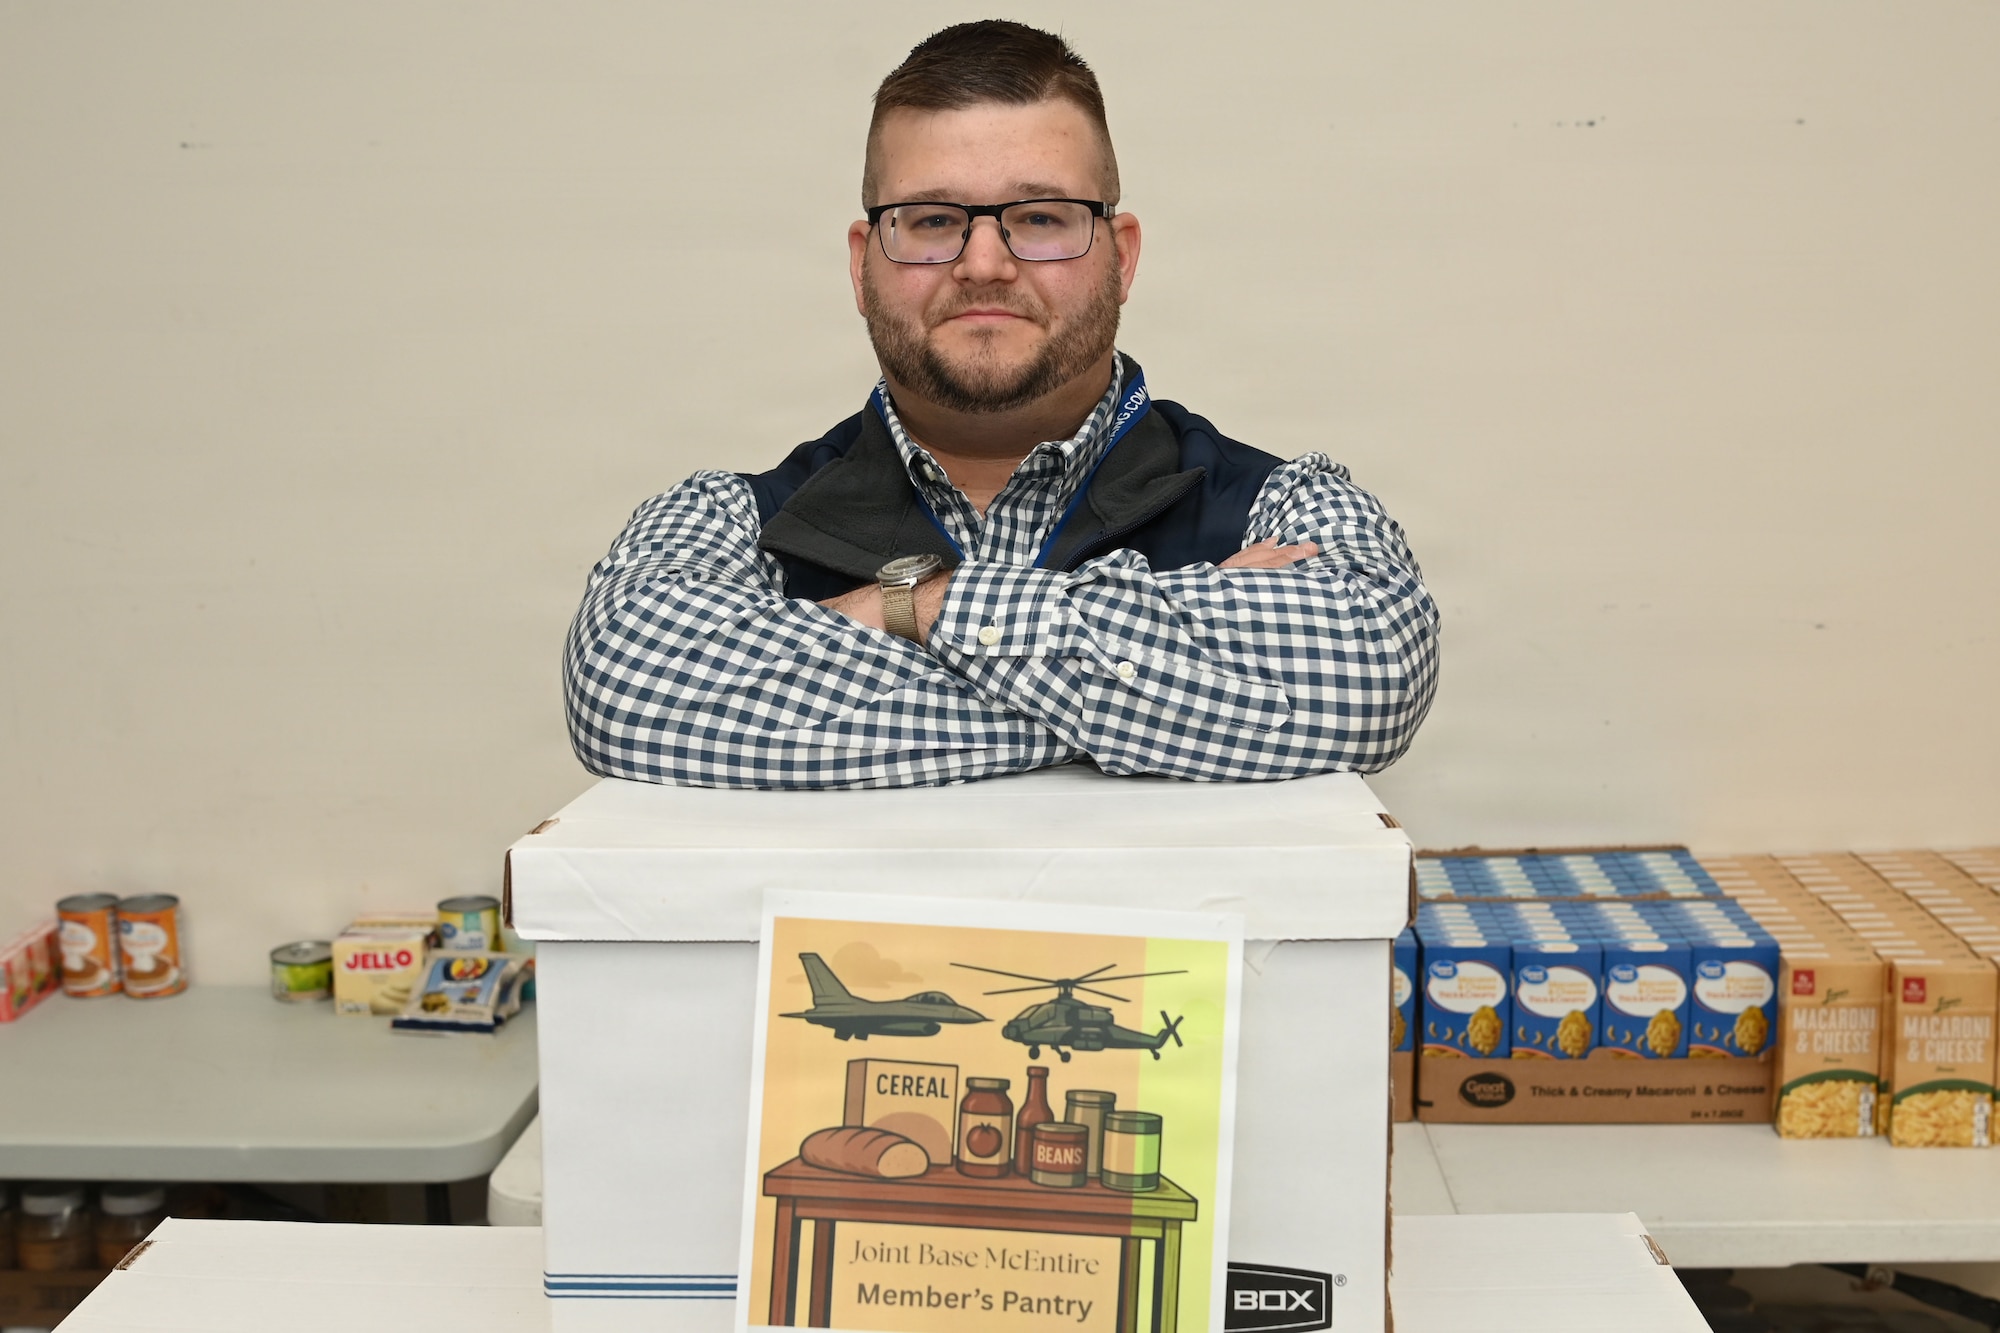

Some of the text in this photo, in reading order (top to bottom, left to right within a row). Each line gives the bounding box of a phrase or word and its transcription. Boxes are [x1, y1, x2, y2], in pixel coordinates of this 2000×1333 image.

[1793, 1007, 1876, 1031] MACARONI
[1903, 1016, 1991, 1039] MACARONI
[1796, 1032, 1871, 1054] & CHEESE
[1906, 1040, 1985, 1063] & CHEESE
[877, 1073, 949, 1099] CEREAL
[1466, 1080, 1506, 1094] Great
[1530, 1084, 1766, 1100] Thick & Creamy Macaroni & Cheese
[1036, 1145, 1082, 1165] BEANS
[849, 1240, 1099, 1275] Joint Base McEntire
[857, 1283, 1093, 1323] Member’s Pantry
[1234, 1290, 1316, 1311] BOX
